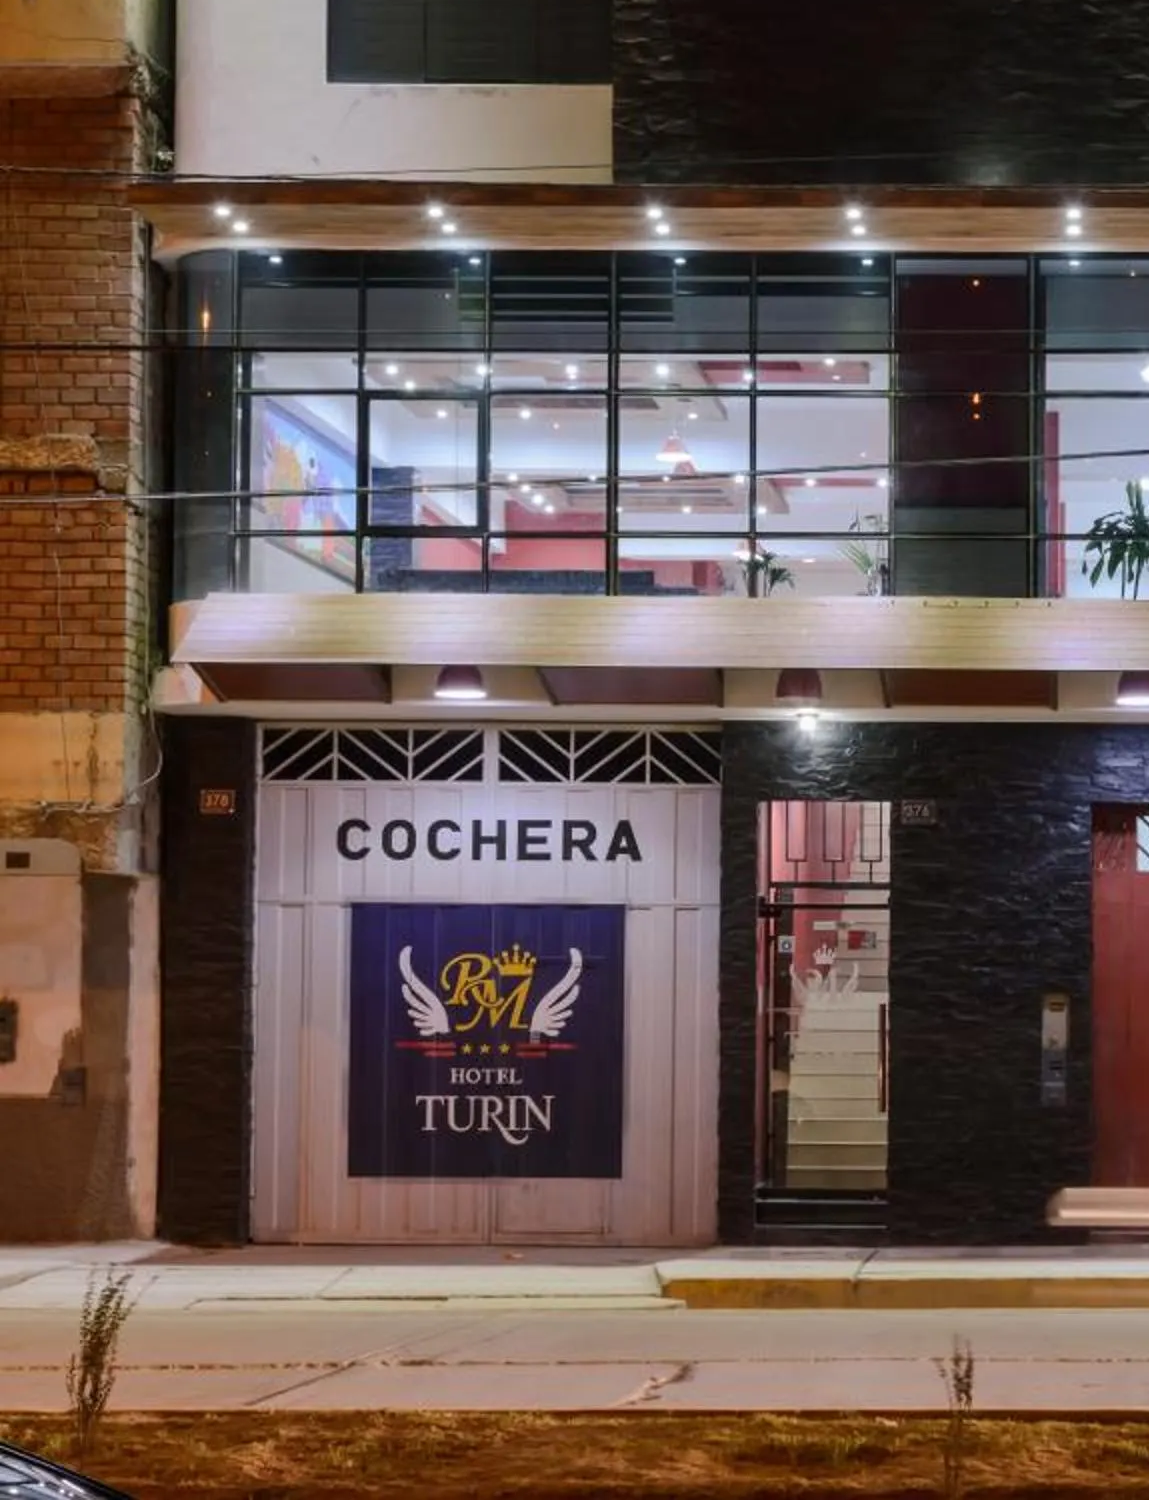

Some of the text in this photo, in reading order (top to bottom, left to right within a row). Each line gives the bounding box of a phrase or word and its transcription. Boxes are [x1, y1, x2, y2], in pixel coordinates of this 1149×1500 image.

[336, 819, 642, 862] COCHERA
[450, 1067, 523, 1085] HOTEL
[415, 1094, 556, 1145] TURIN
